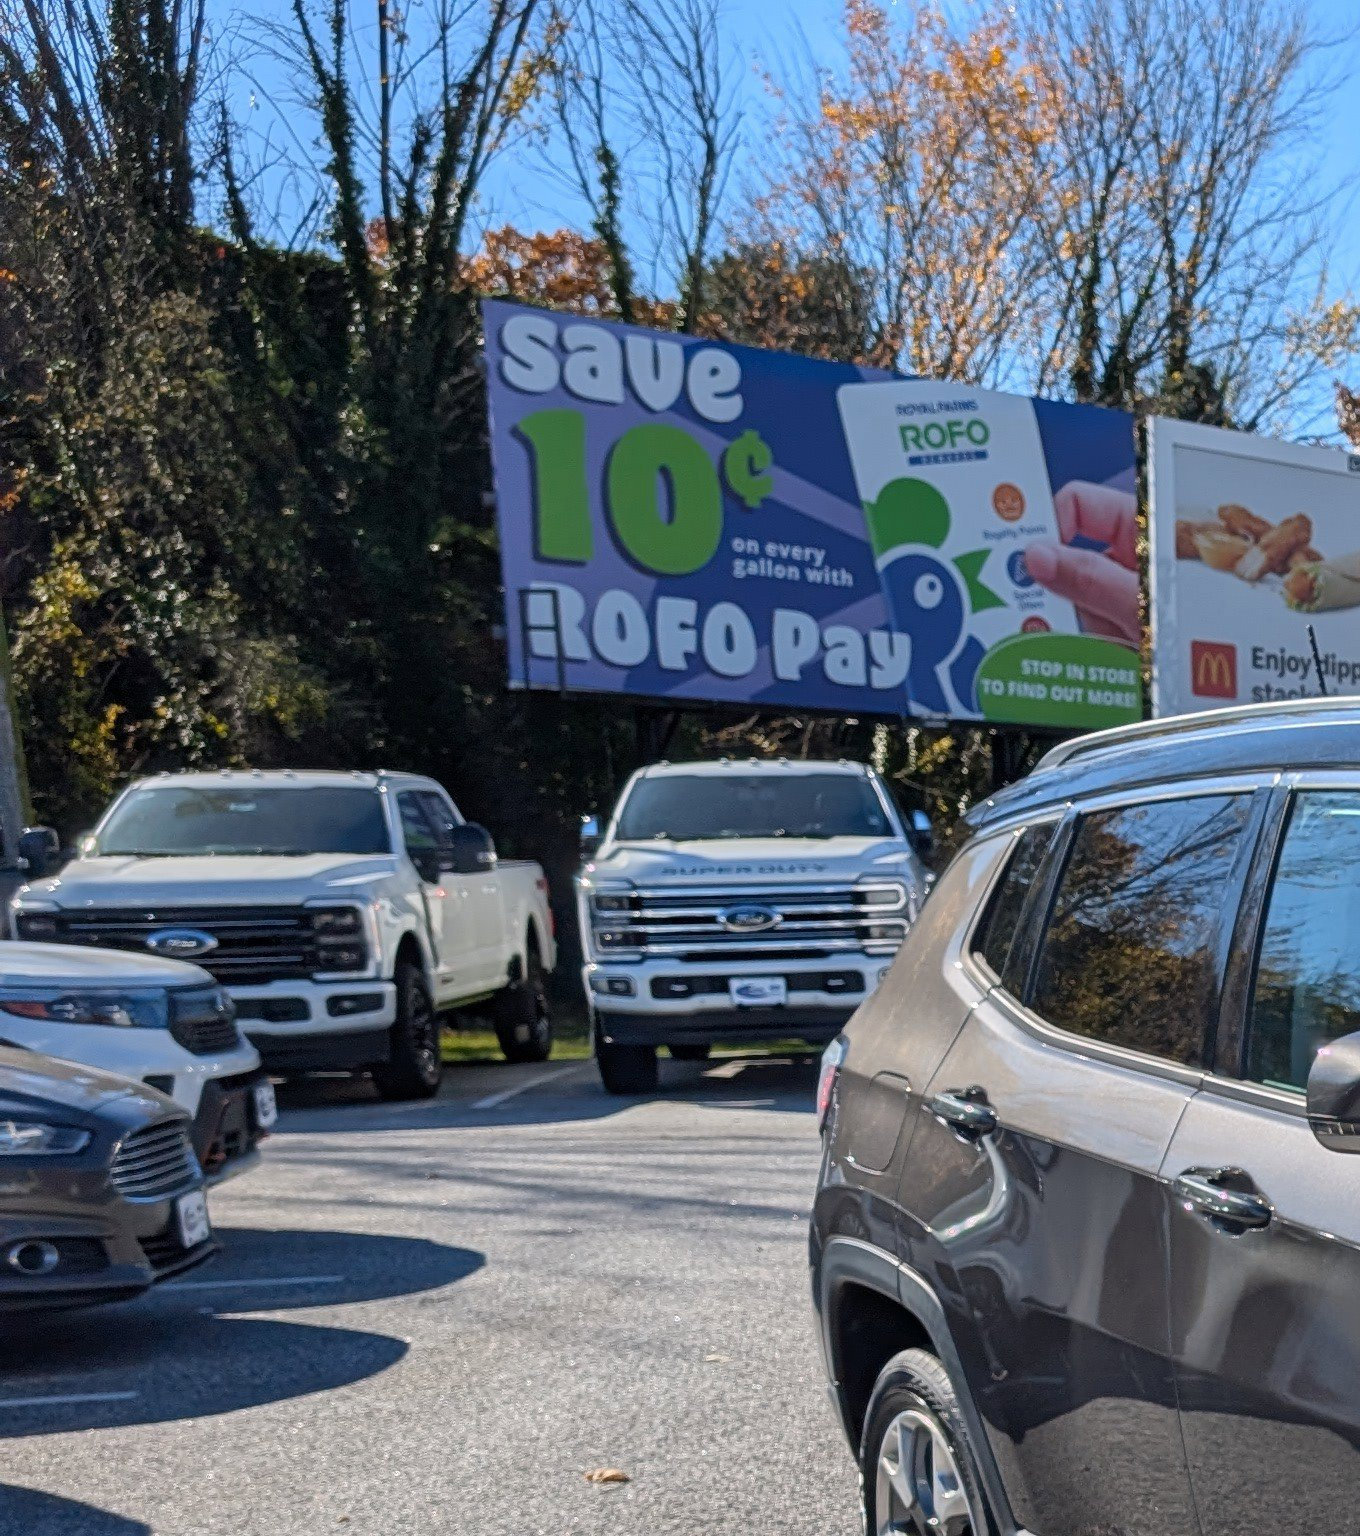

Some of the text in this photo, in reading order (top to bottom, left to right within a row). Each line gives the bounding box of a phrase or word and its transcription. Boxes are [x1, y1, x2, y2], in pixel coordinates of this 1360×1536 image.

[899, 418, 990, 453] ROFO
[731, 537, 826, 567] on every
[732, 558, 854, 588] gallon with
[773, 608, 911, 689] Pay
[1252, 646, 1311, 680] Enjoy
[1021, 659, 1136, 685] STOP IN STORE
[979, 678, 1004, 696] TO
[1007, 681, 1047, 699] FIND
[1051, 685, 1083, 702] OUT
